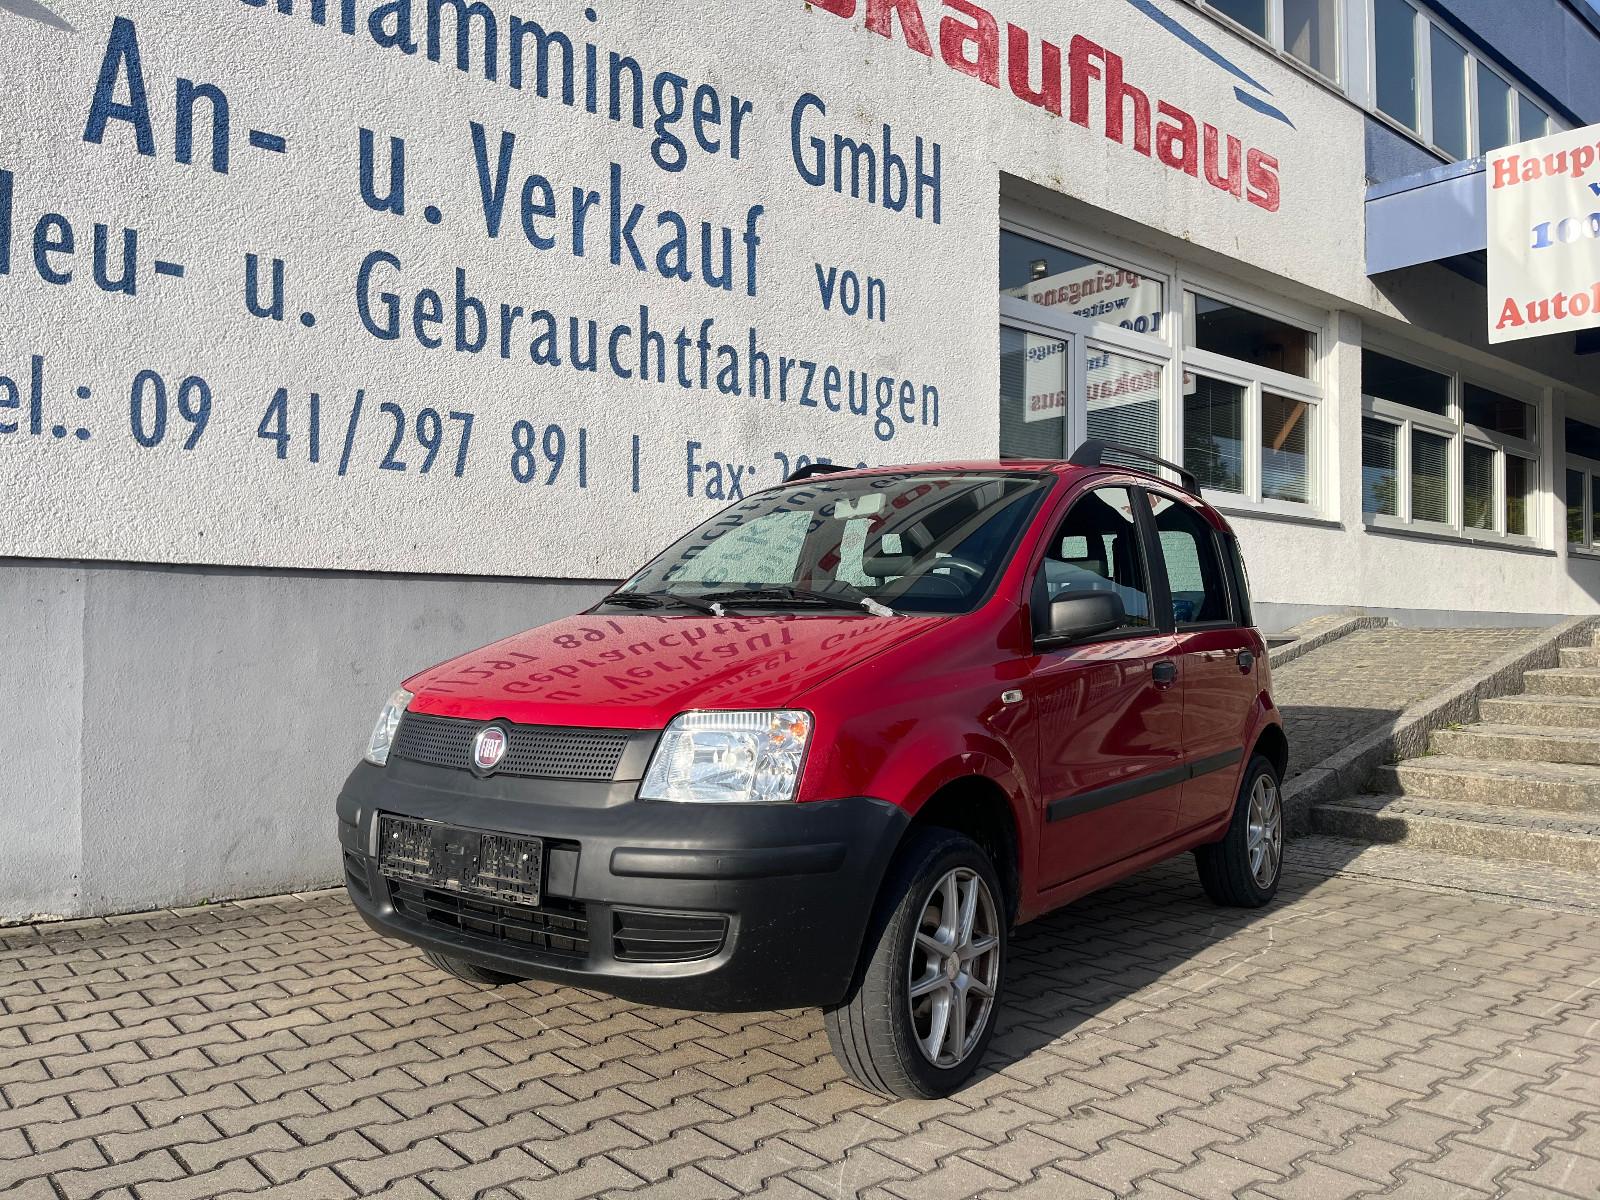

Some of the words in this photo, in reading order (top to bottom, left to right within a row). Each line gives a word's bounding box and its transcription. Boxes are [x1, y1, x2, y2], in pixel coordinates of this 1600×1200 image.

[83, 16, 286, 174] An-
[359, 127, 443, 224] u.
[470, 121, 765, 297] Verkauf
[815, 263, 887, 322] von
[240, 0, 753, 172] amminger
[791, 93, 941, 224] GmbH
[802, 0, 1280, 213] aufhaus
[1492, 142, 1600, 189] Haup
[0, 168, 184, 295] eu-
[246, 253, 316, 328] u.
[356, 250, 940, 441] Gebrauchtfahrzeugen
[130, 369, 212, 450] 09
[257, 387, 475, 477] 41/297
[511, 420, 587, 488] 891
[480, 738, 502, 758] FIAT
